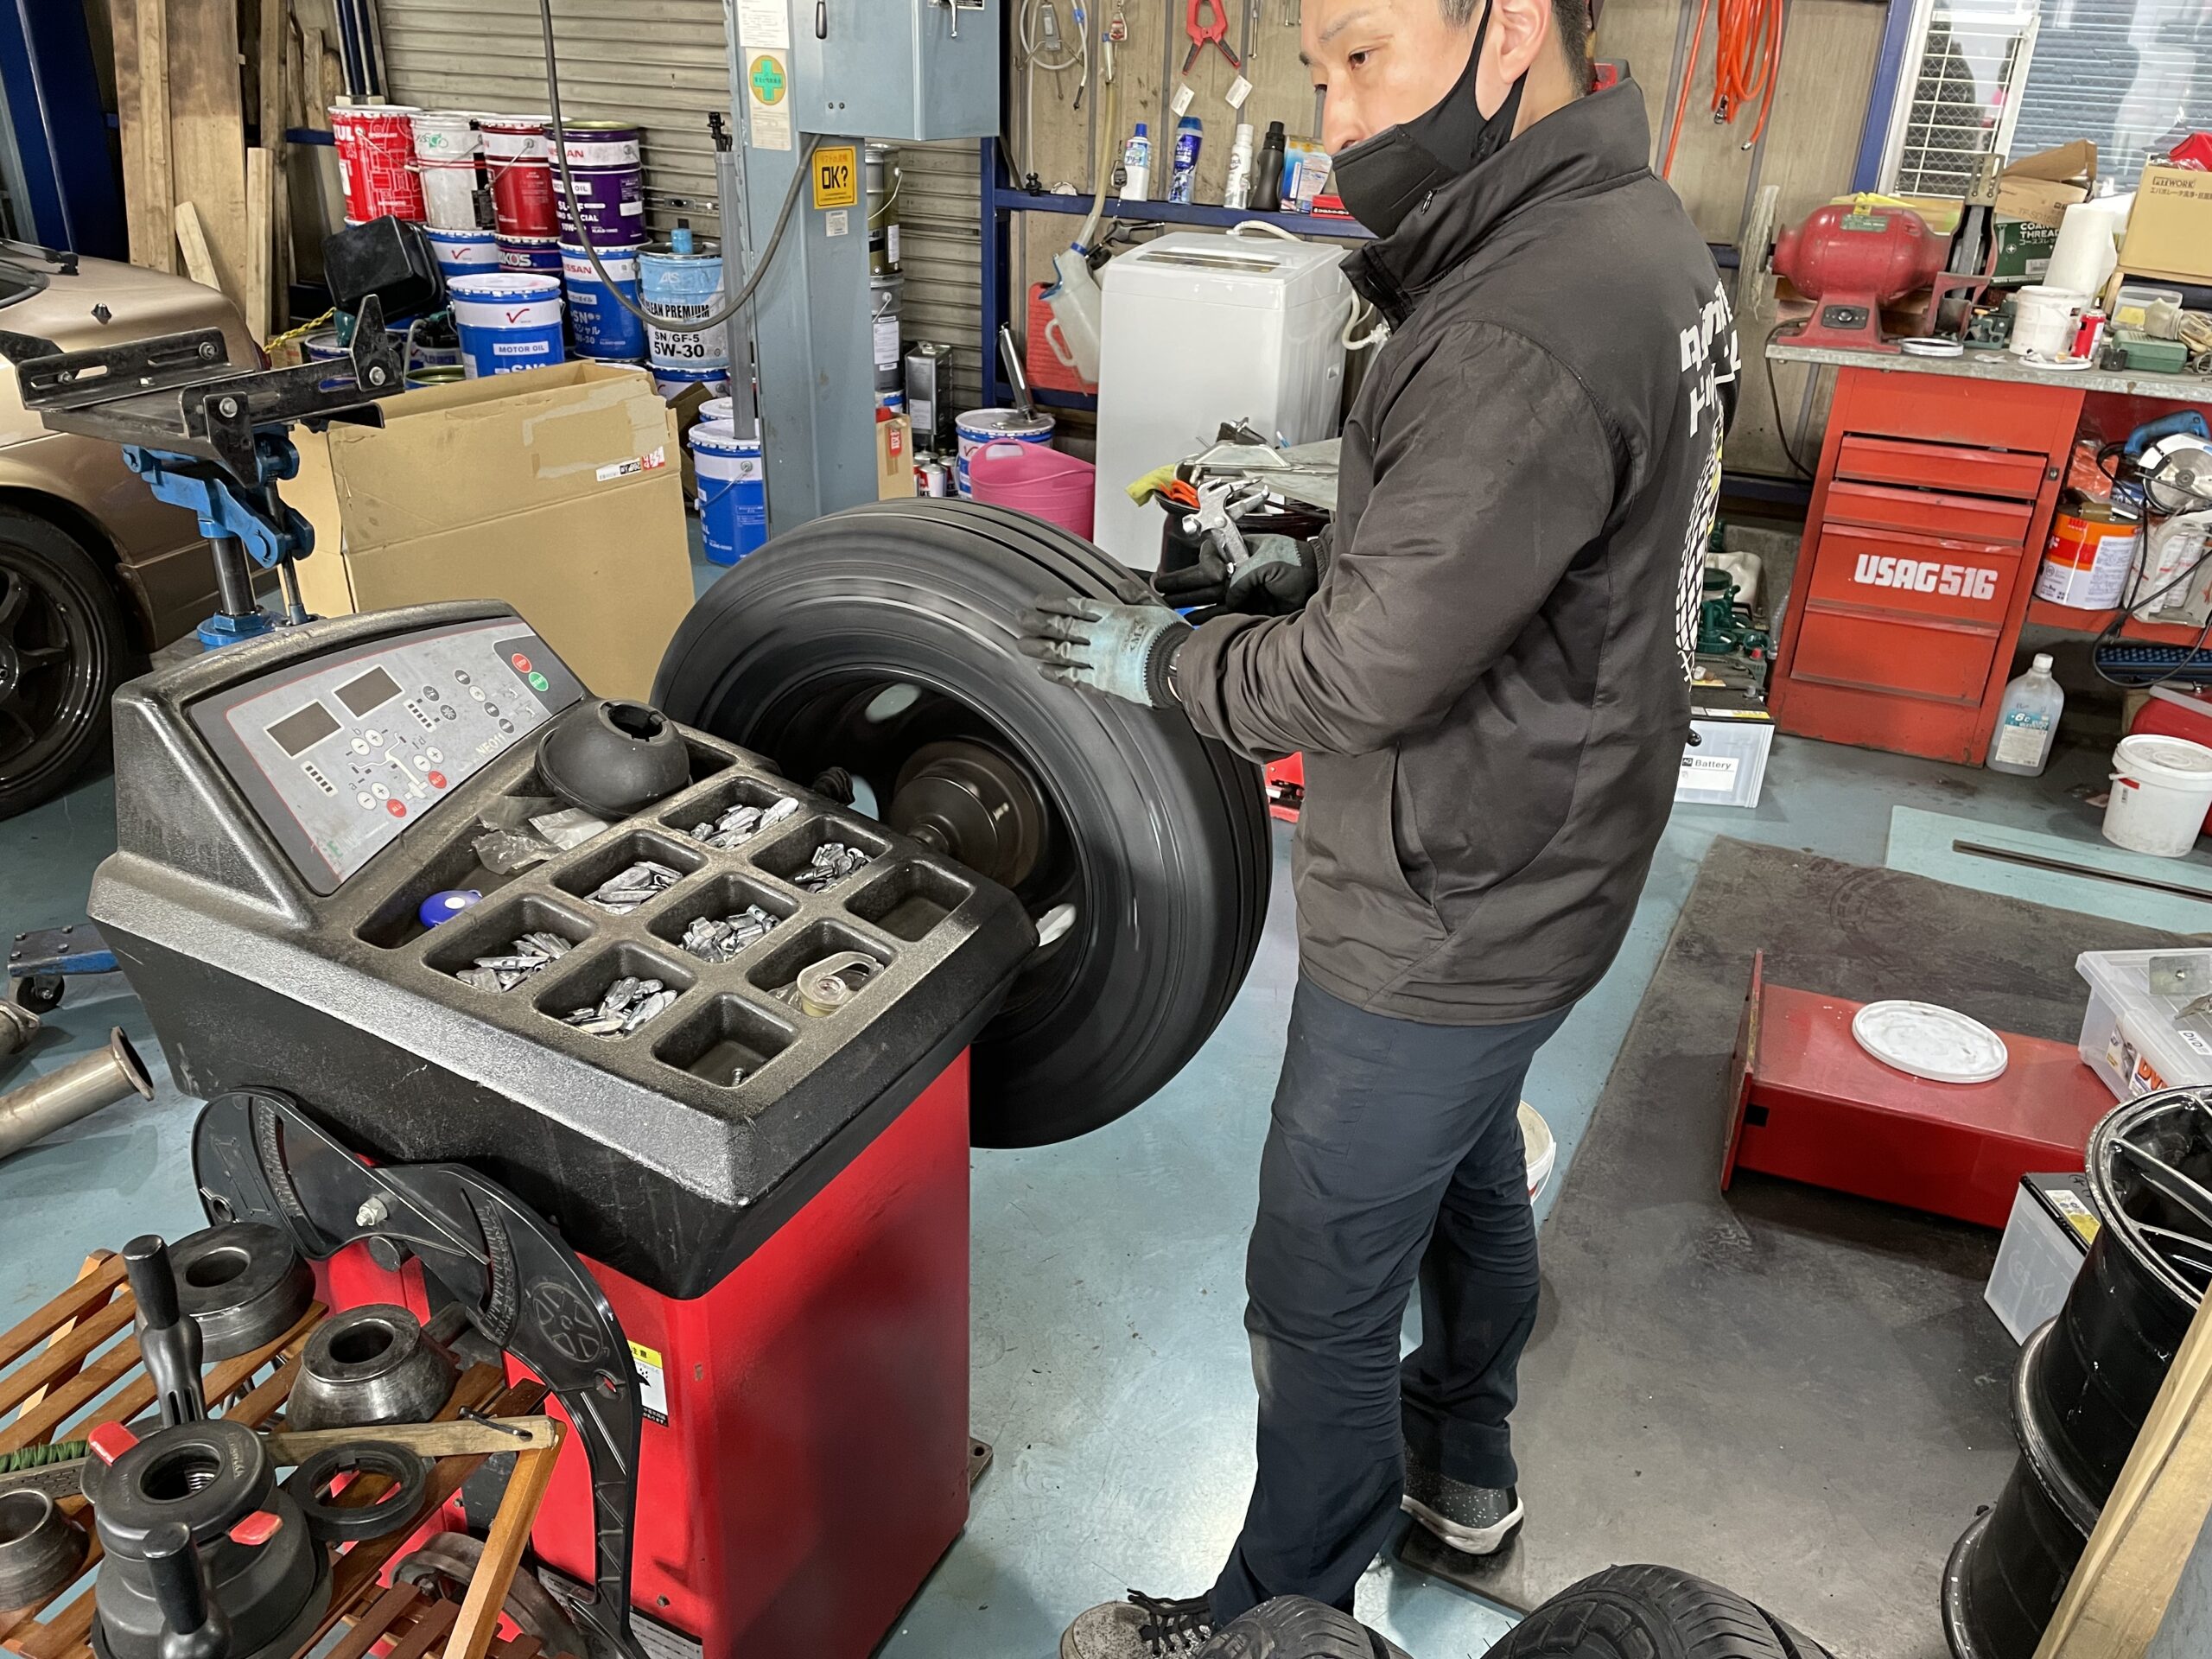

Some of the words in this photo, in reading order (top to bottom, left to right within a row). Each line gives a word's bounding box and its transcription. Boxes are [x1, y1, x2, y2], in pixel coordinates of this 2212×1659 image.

[822, 165, 849, 189] OK?
[665, 304, 710, 318] PREMIUM
[654, 331, 700, 342] SN/GF-5
[654, 342, 705, 358] 5W-30
[1854, 553, 1941, 593] USAG
[1938, 563, 1998, 600] 516
[1694, 759, 1732, 770] Battery
[2183, 1032, 2203, 1047] DVD
